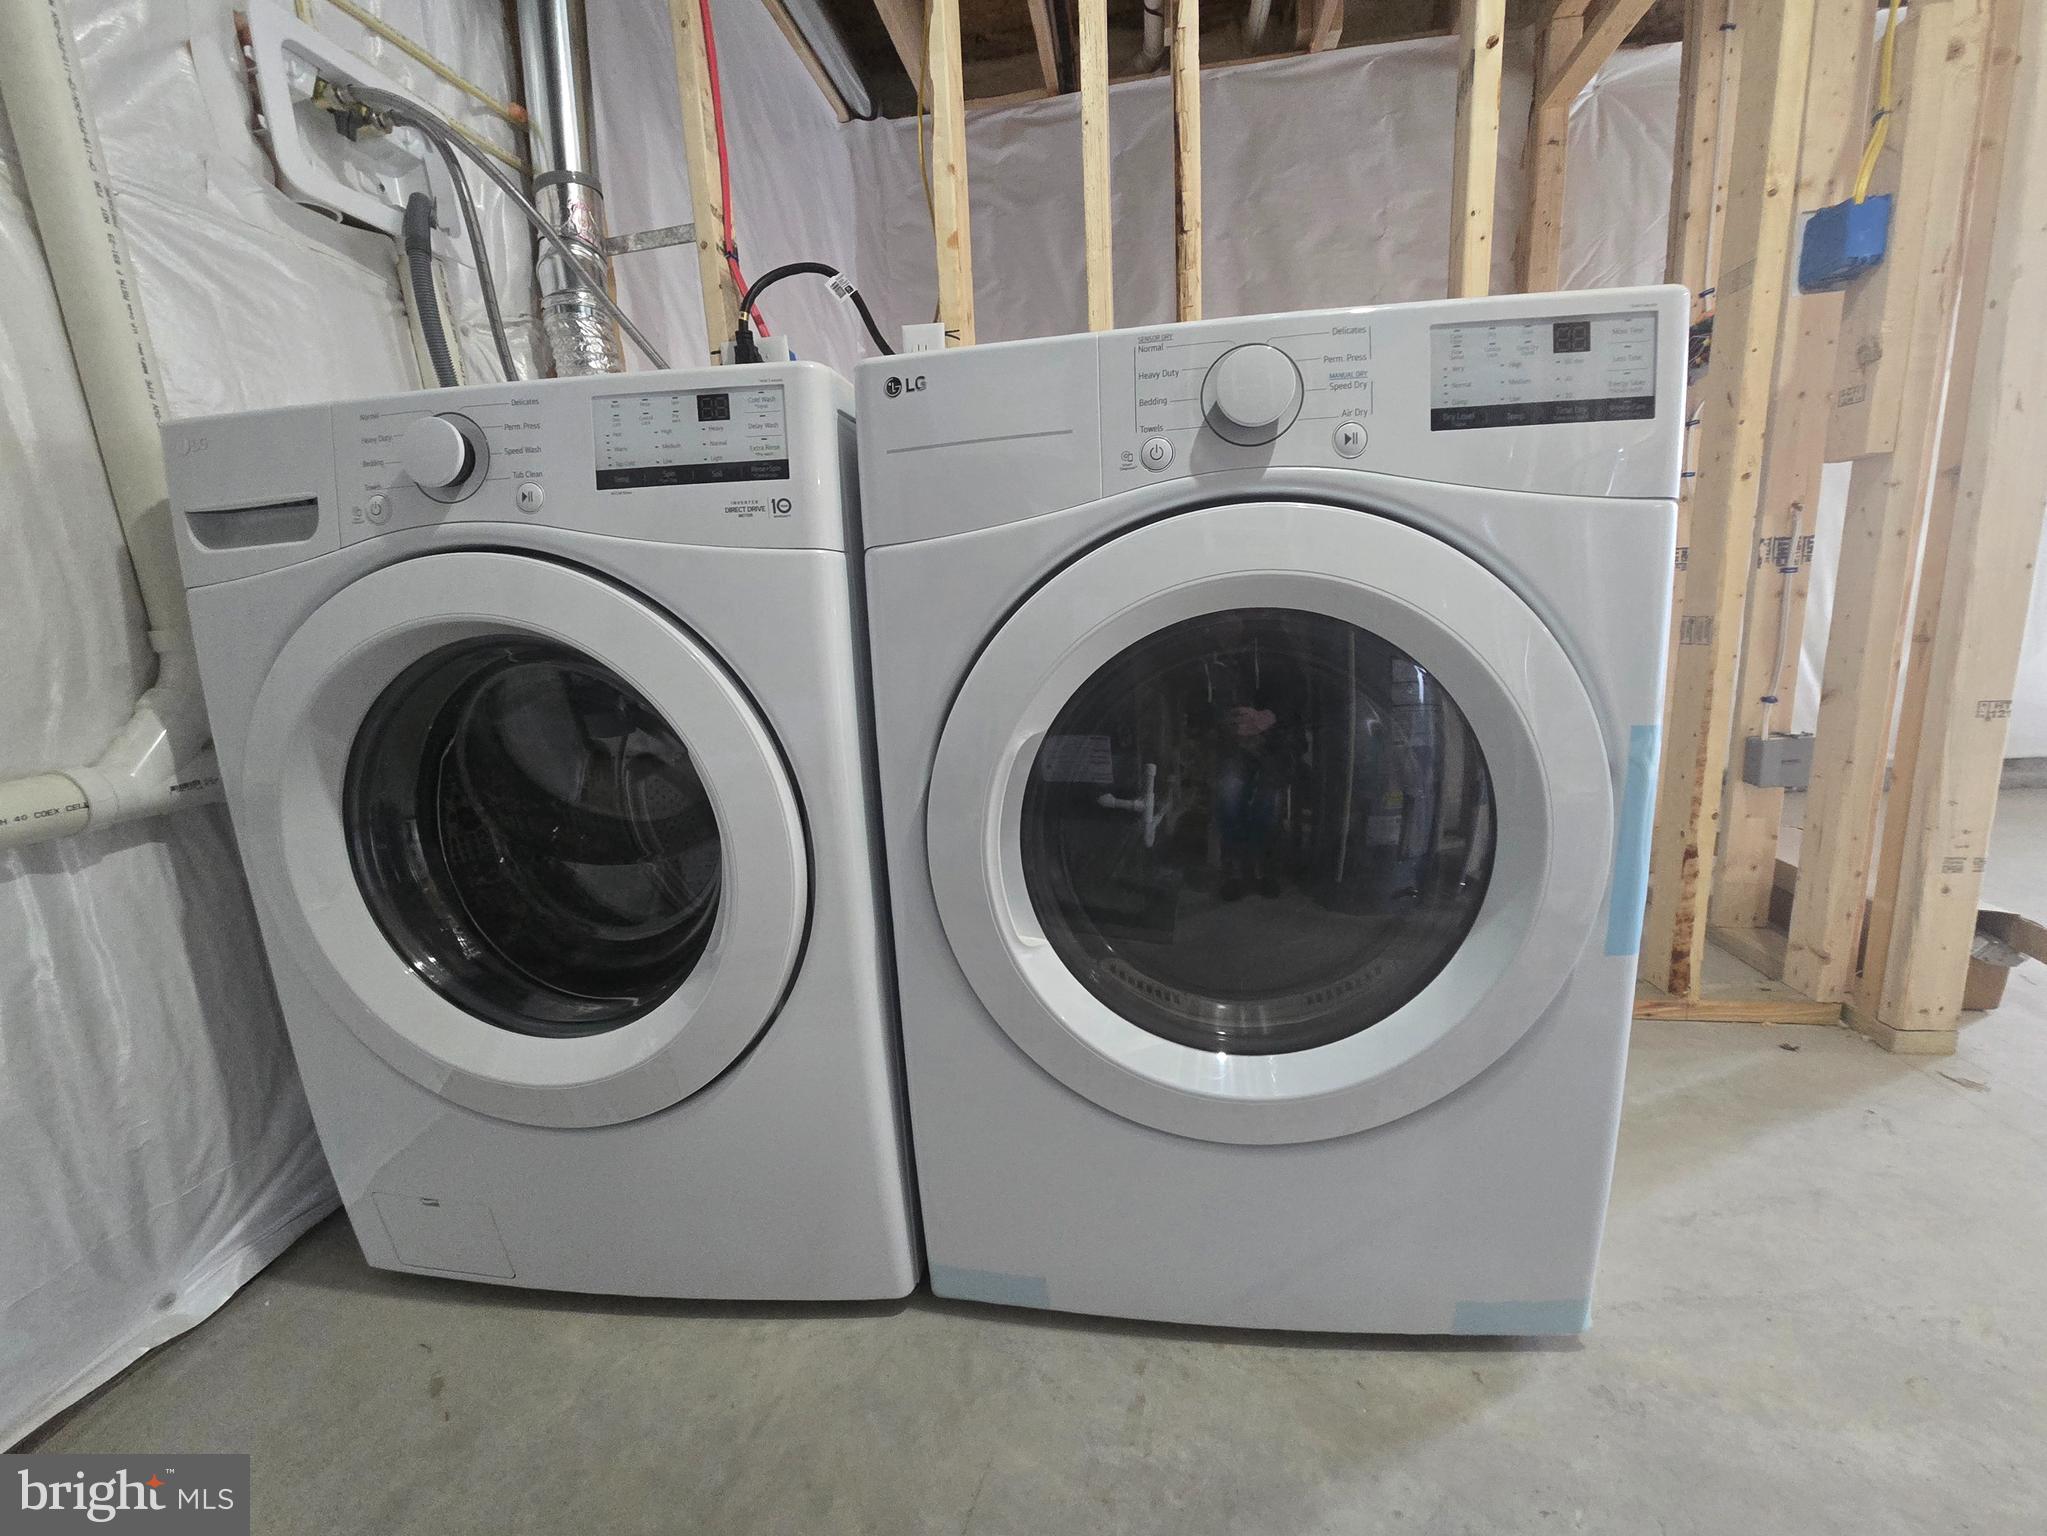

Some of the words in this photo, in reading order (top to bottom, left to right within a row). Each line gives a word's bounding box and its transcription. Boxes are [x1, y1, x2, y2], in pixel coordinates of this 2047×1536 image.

[1332, 327, 1368, 336] Delicates
[1138, 343, 1164, 352] Normal
[1346, 354, 1368, 362] Press
[1139, 371, 1160, 380] Heavy
[1162, 368, 1180, 378] Duty
[905, 375, 928, 392] LG
[1329, 382, 1352, 391] Speed
[1354, 380, 1368, 390] Dry
[511, 398, 540, 406] Delicates
[1139, 398, 1168, 407] Bedding
[1341, 409, 1353, 418] Air
[1354, 408, 1369, 418] Dry
[523, 422, 541, 430] Press
[747, 423, 763, 431] Delay
[764, 421, 780, 429] Wash
[1140, 424, 1164, 434] Towels
[504, 447, 524, 456] Speed
[525, 444, 542, 454] Wash
[512, 471, 524, 479] Tub
[525, 470, 543, 479] Clean
[771, 498, 792, 514] 10
[34, 808, 60, 819] COEX
